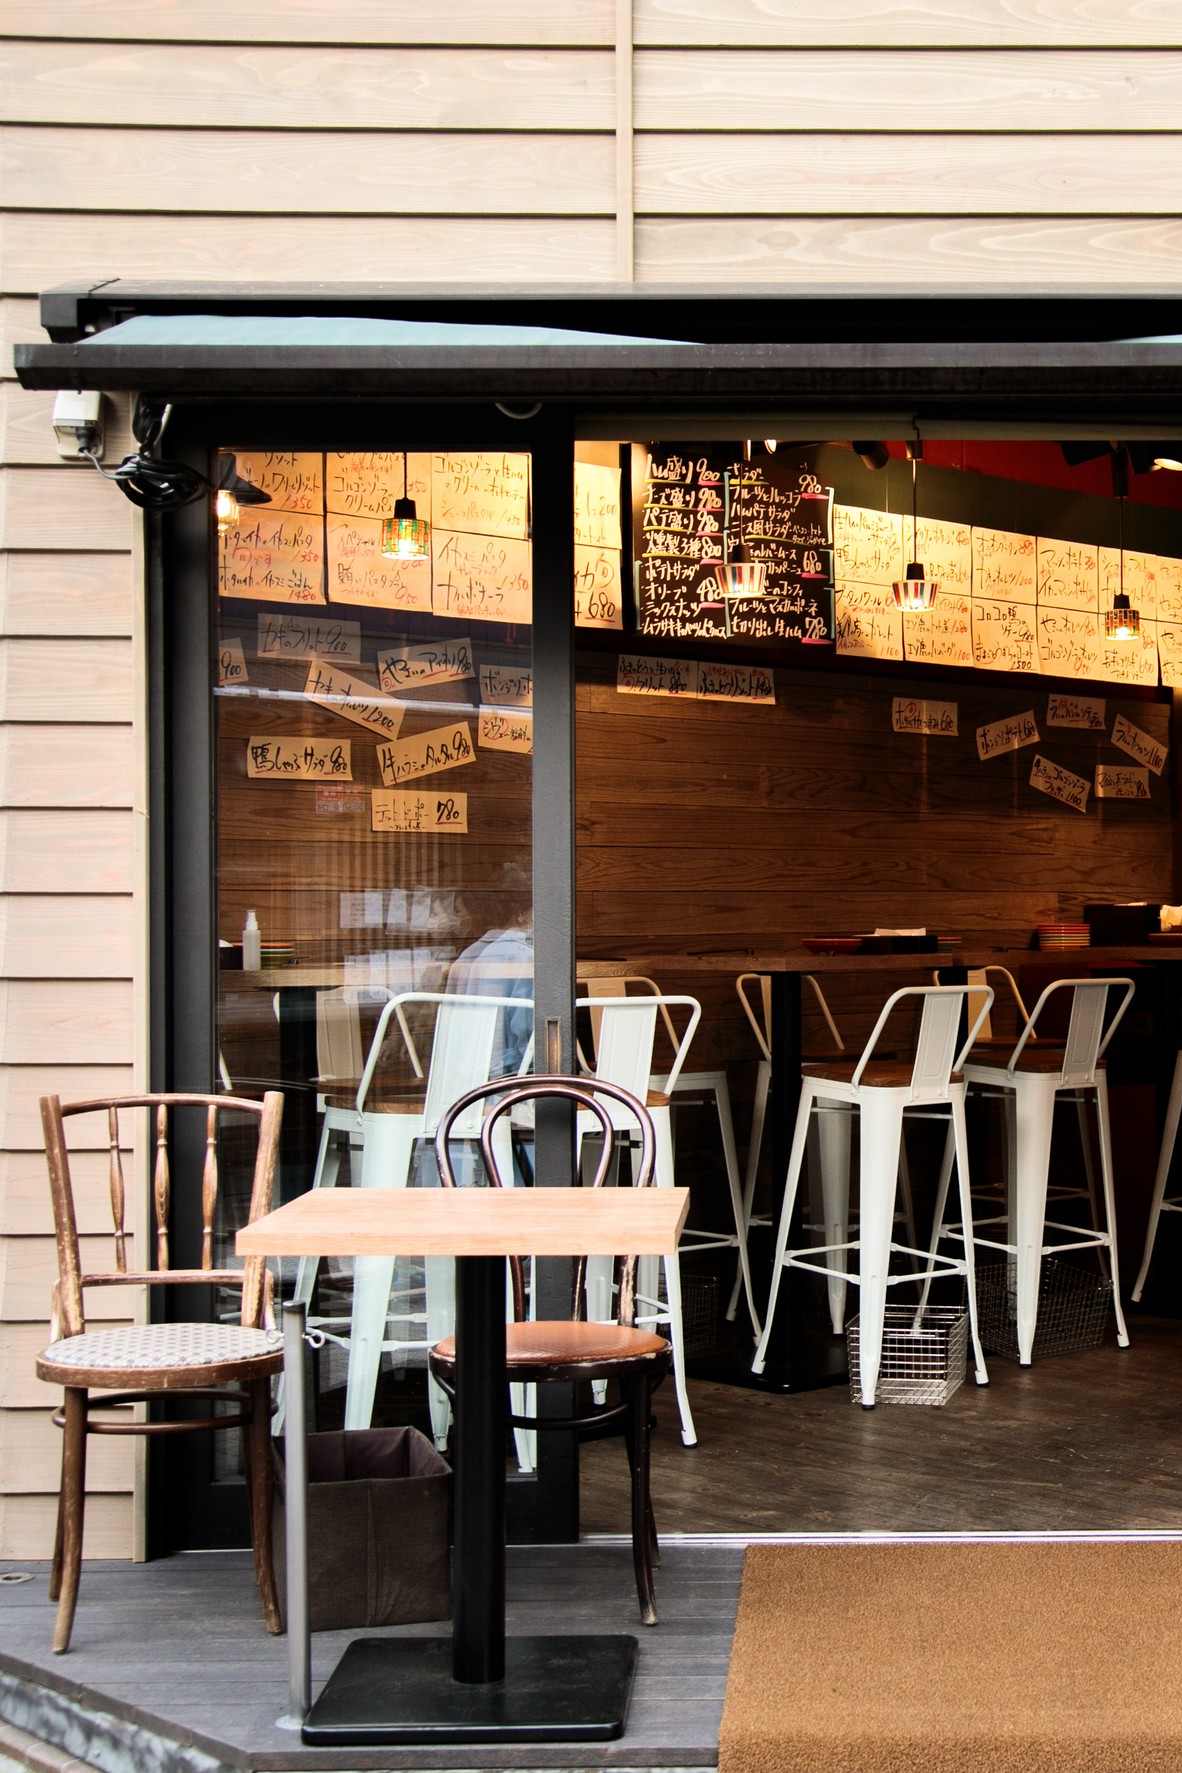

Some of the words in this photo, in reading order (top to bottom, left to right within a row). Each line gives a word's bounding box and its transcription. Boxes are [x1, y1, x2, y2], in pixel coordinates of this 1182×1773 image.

[645, 453, 693, 483] ハム盛り
[642, 483, 695, 508] チーズ盛り
[799, 474, 821, 493] 980
[345, 494, 393, 513] クリームパス
[643, 507, 694, 534] パテ盛り
[645, 557, 700, 582] ポテトサラダ
[803, 550, 822, 574] 680
[588, 591, 616, 619] 680
[645, 598, 701, 618] ミックスナッツ
[804, 616, 828, 639] 780
[251, 742, 328, 773] 鴨しゃぶサラダ
[436, 798, 460, 823] 780
